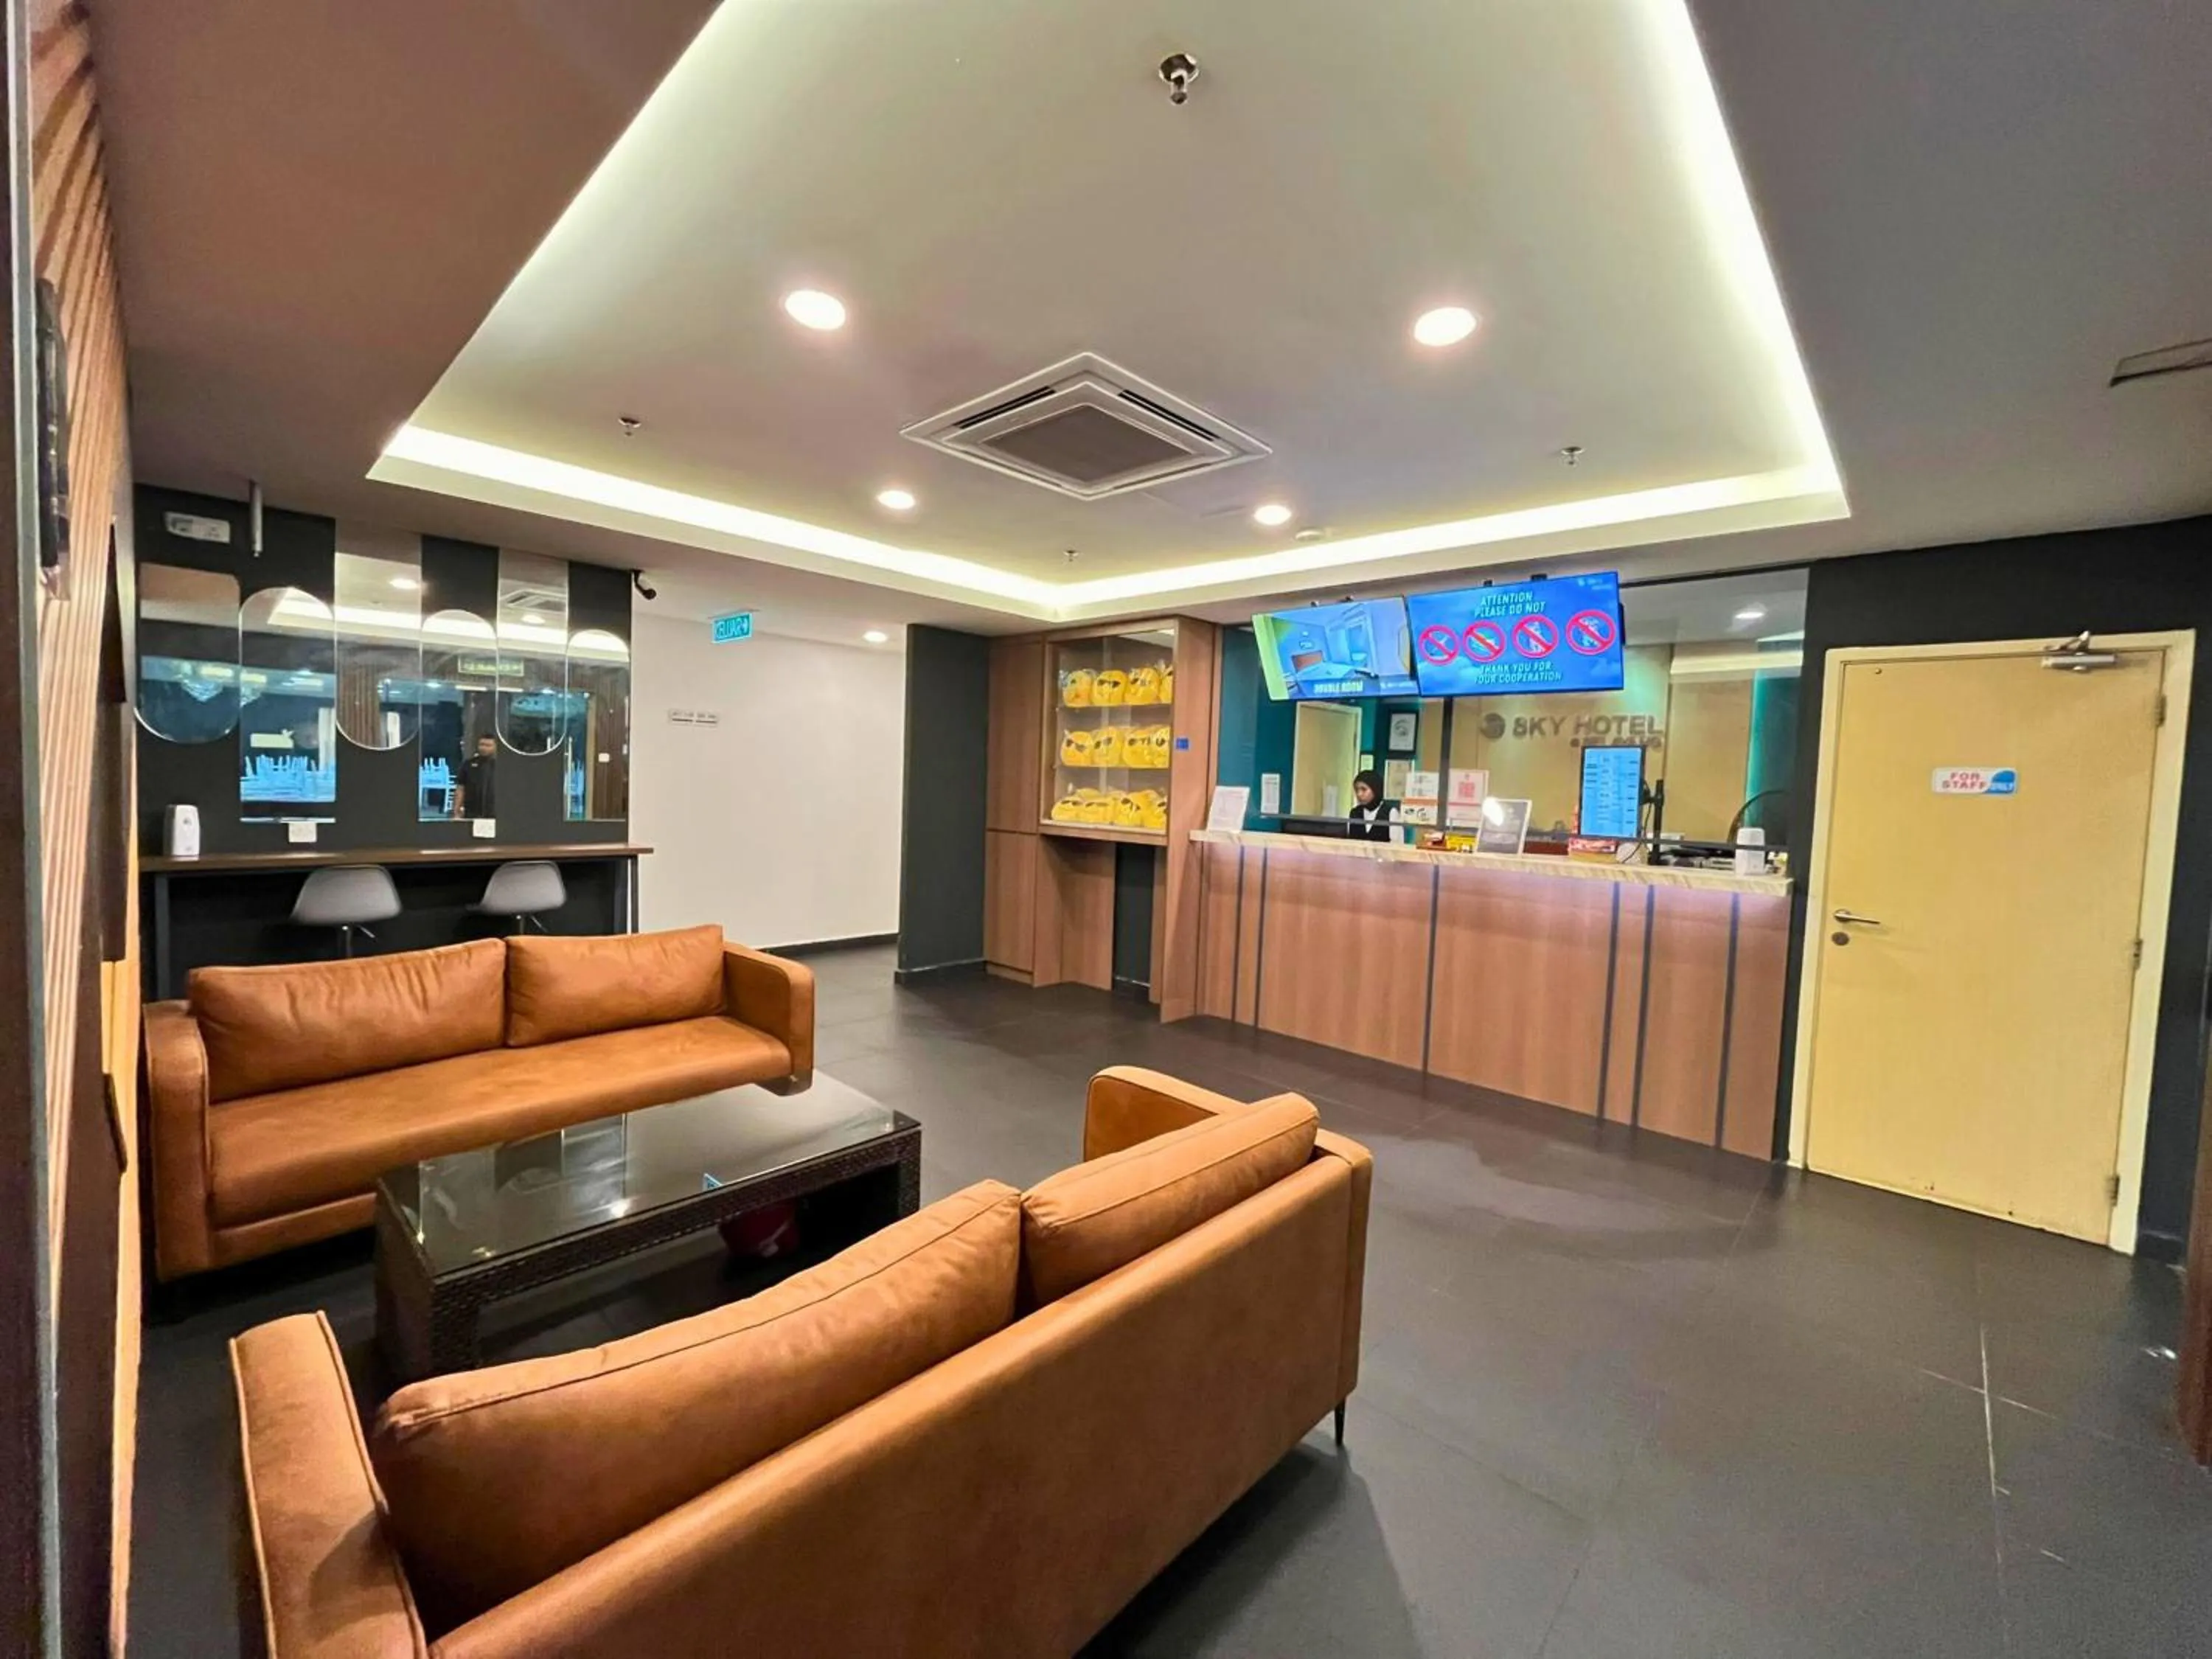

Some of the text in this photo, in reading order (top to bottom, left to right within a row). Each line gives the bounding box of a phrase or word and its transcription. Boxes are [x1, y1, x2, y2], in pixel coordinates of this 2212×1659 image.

[1480, 591, 1534, 606] ATTENTION
[1475, 601, 1546, 619] PLEASE DO NOT
[1480, 661, 1554, 674] THANK YOU FOR
[1475, 671, 1563, 685] YOUR COOPERATION
[1513, 714, 1664, 737] SKY HOTEL
[1950, 771, 1980, 781] FOR
[1941, 780, 1988, 790] STAFF
